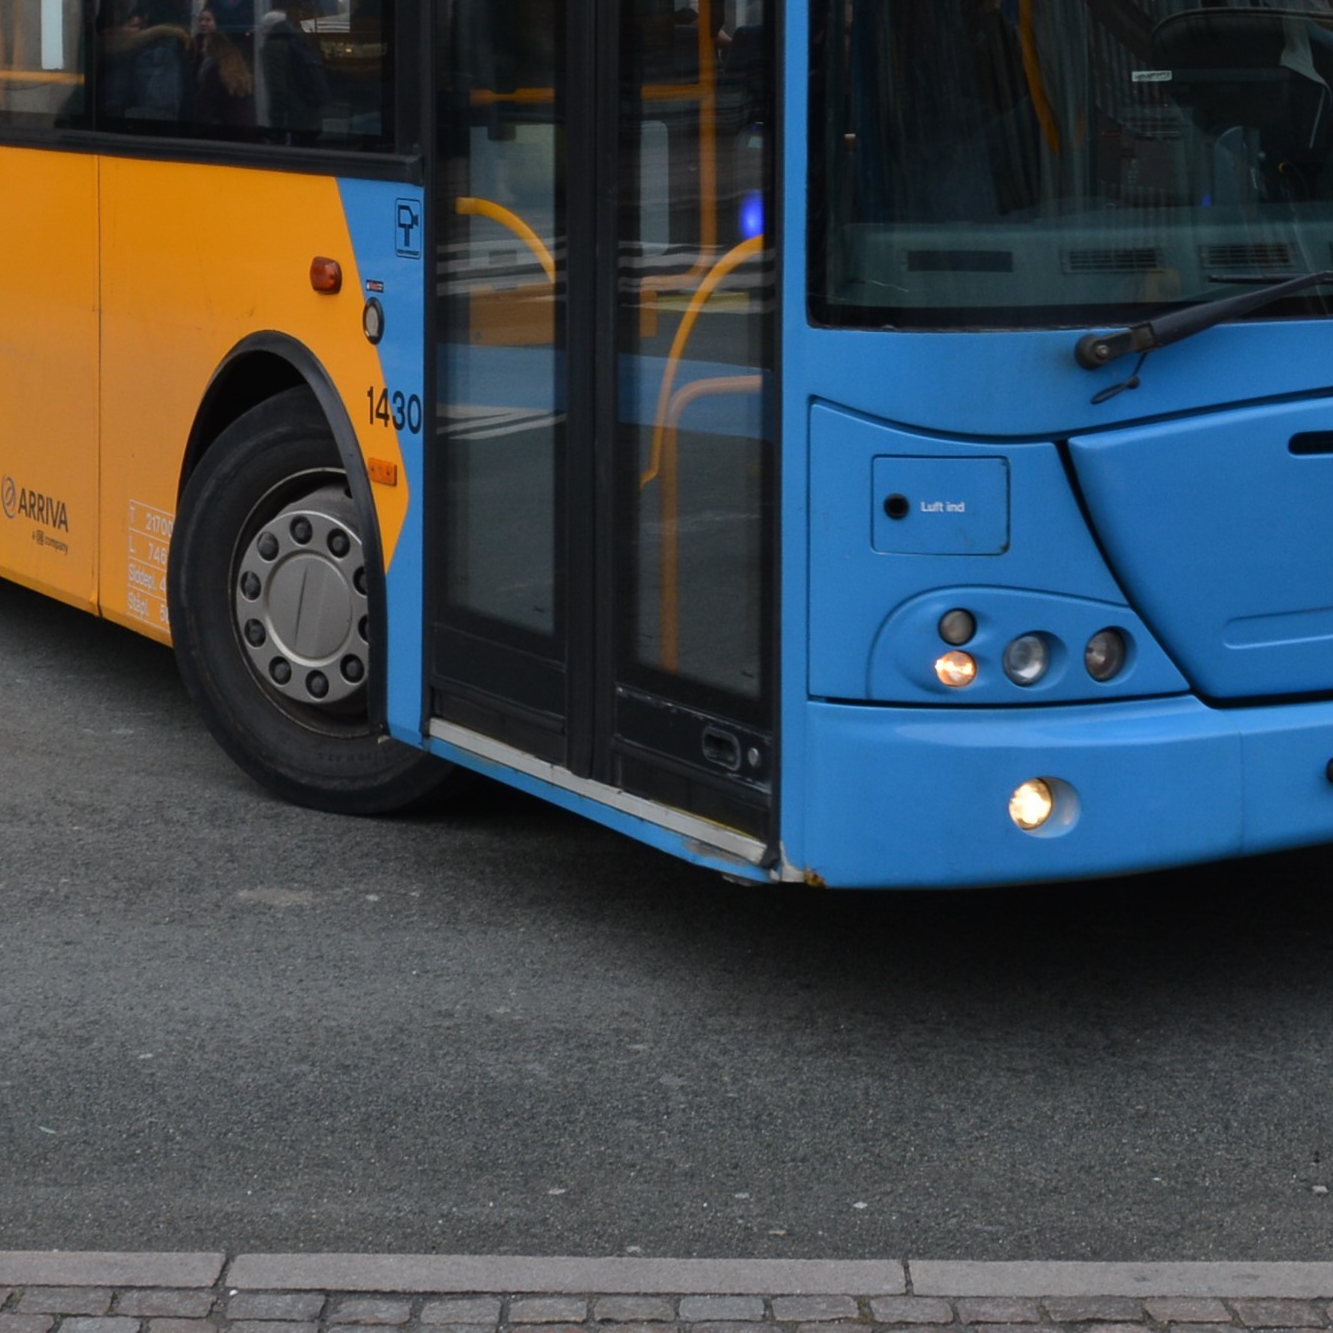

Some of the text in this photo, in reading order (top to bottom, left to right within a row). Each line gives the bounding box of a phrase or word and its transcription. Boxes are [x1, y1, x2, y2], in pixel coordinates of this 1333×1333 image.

[367, 385, 422, 434] 1430
[18, 487, 68, 533] ARRIVA
[920, 502, 965, 512] Luft ind
